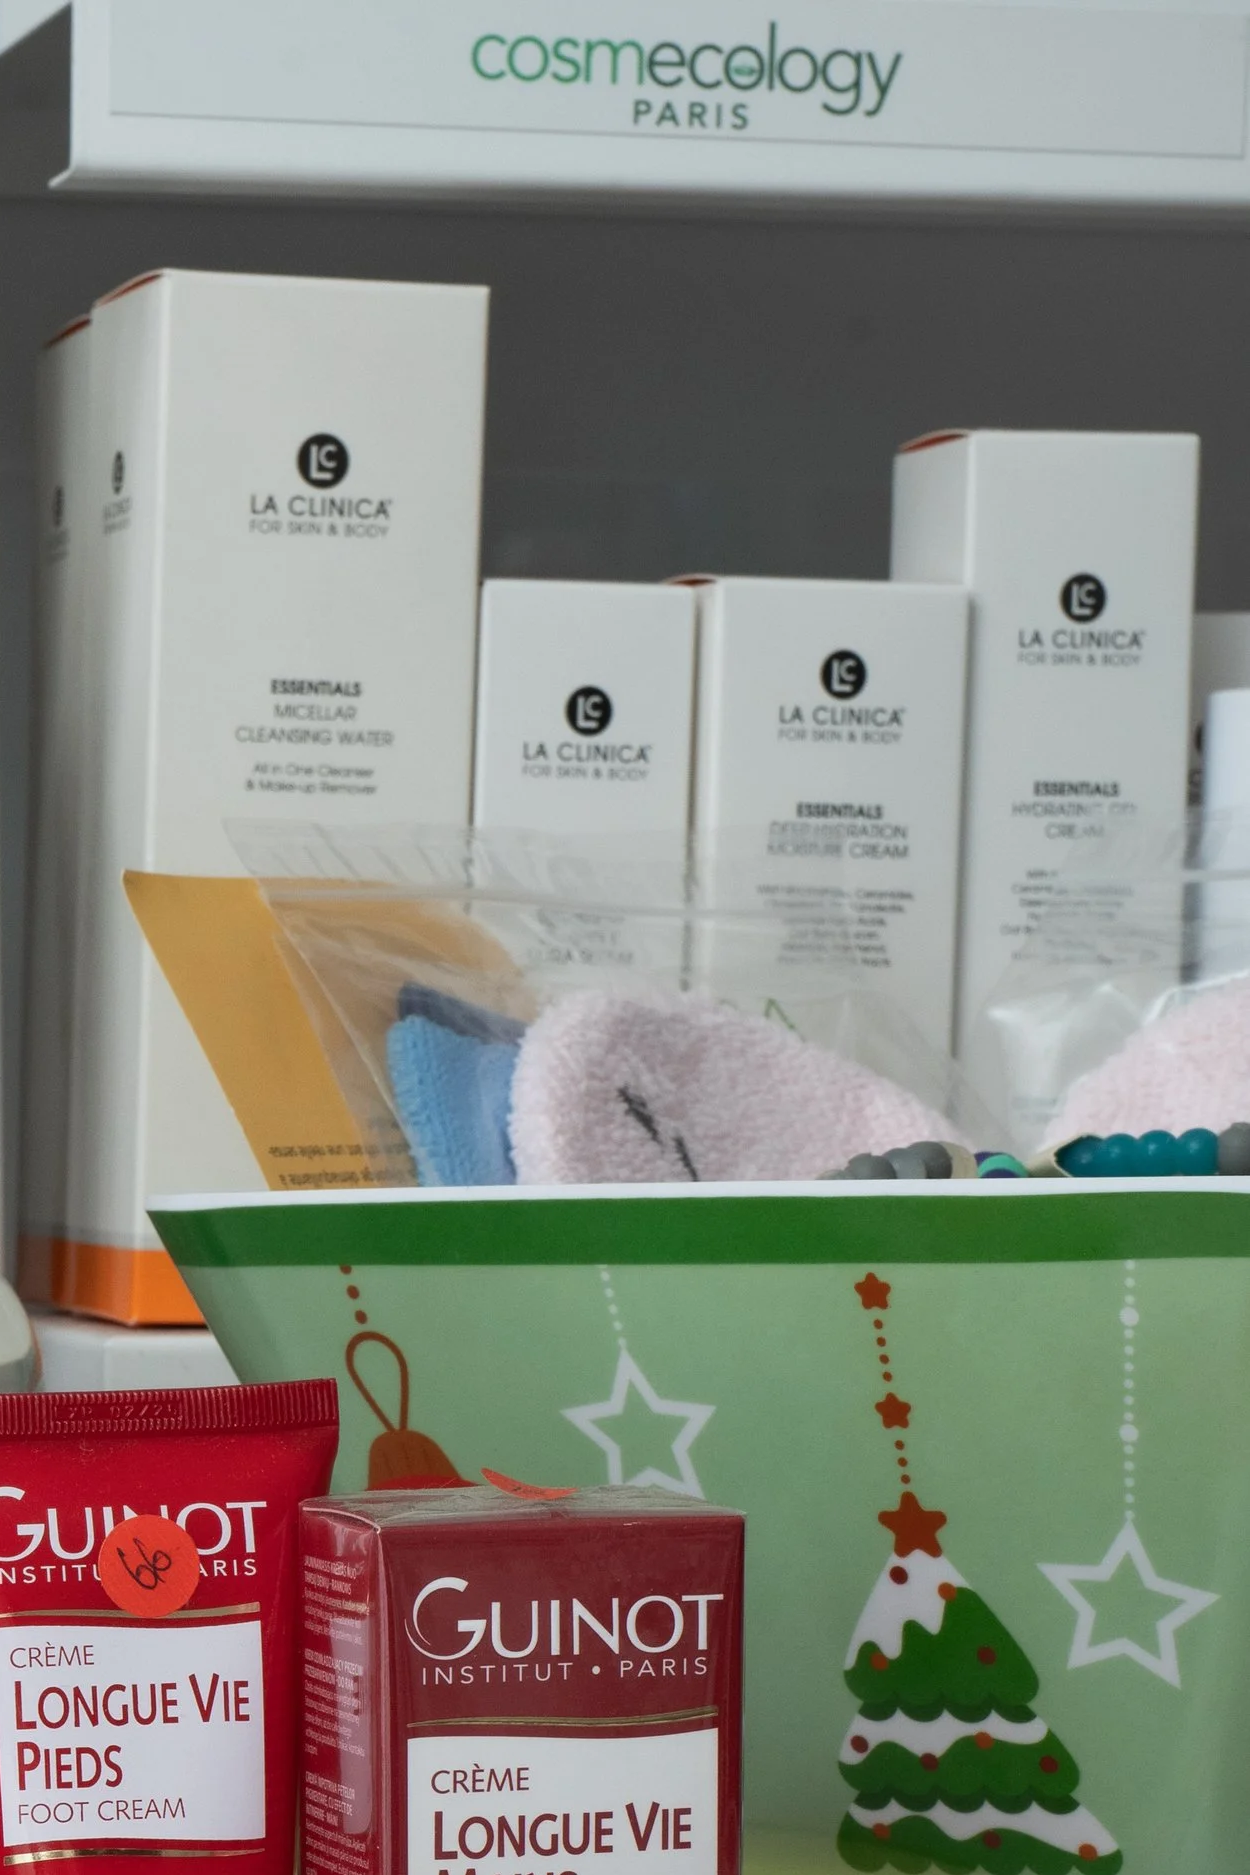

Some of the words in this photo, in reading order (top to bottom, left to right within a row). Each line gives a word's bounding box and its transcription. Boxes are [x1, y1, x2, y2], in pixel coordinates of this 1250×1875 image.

[471, 22, 903, 117] cosmecology
[633, 100, 750, 130] PARIS
[250, 496, 278, 516] LA
[289, 496, 392, 520] CLINICA
[1018, 630, 1043, 648] LA
[1052, 630, 1144, 650] CLINICA
[270, 679, 362, 698] ESSENTIALS
[273, 704, 357, 722] MICELLAR
[779, 706, 804, 725] LA
[812, 706, 904, 727] CLINICA
[1034, 780, 1121, 798] ESSENTIALS
[796, 802, 884, 820] ESSENTIALS
[405, 1576, 724, 1661] GUINOT
[9, 1641, 95, 1669] CRÈME
[422, 1661, 573, 1686] INSTITUT
[619, 1656, 708, 1678] PARIS
[15, 1680, 180, 1730] LONGUE
[188, 1672, 250, 1723] VIE
[17, 1741, 124, 1791] PIEDS
[431, 1764, 530, 1795] CRÈME
[18, 1800, 89, 1824] FOOT
[97, 1798, 186, 1821] CREAM
[433, 1810, 614, 1861] LONGUE
[625, 1801, 692, 1851] VIE
